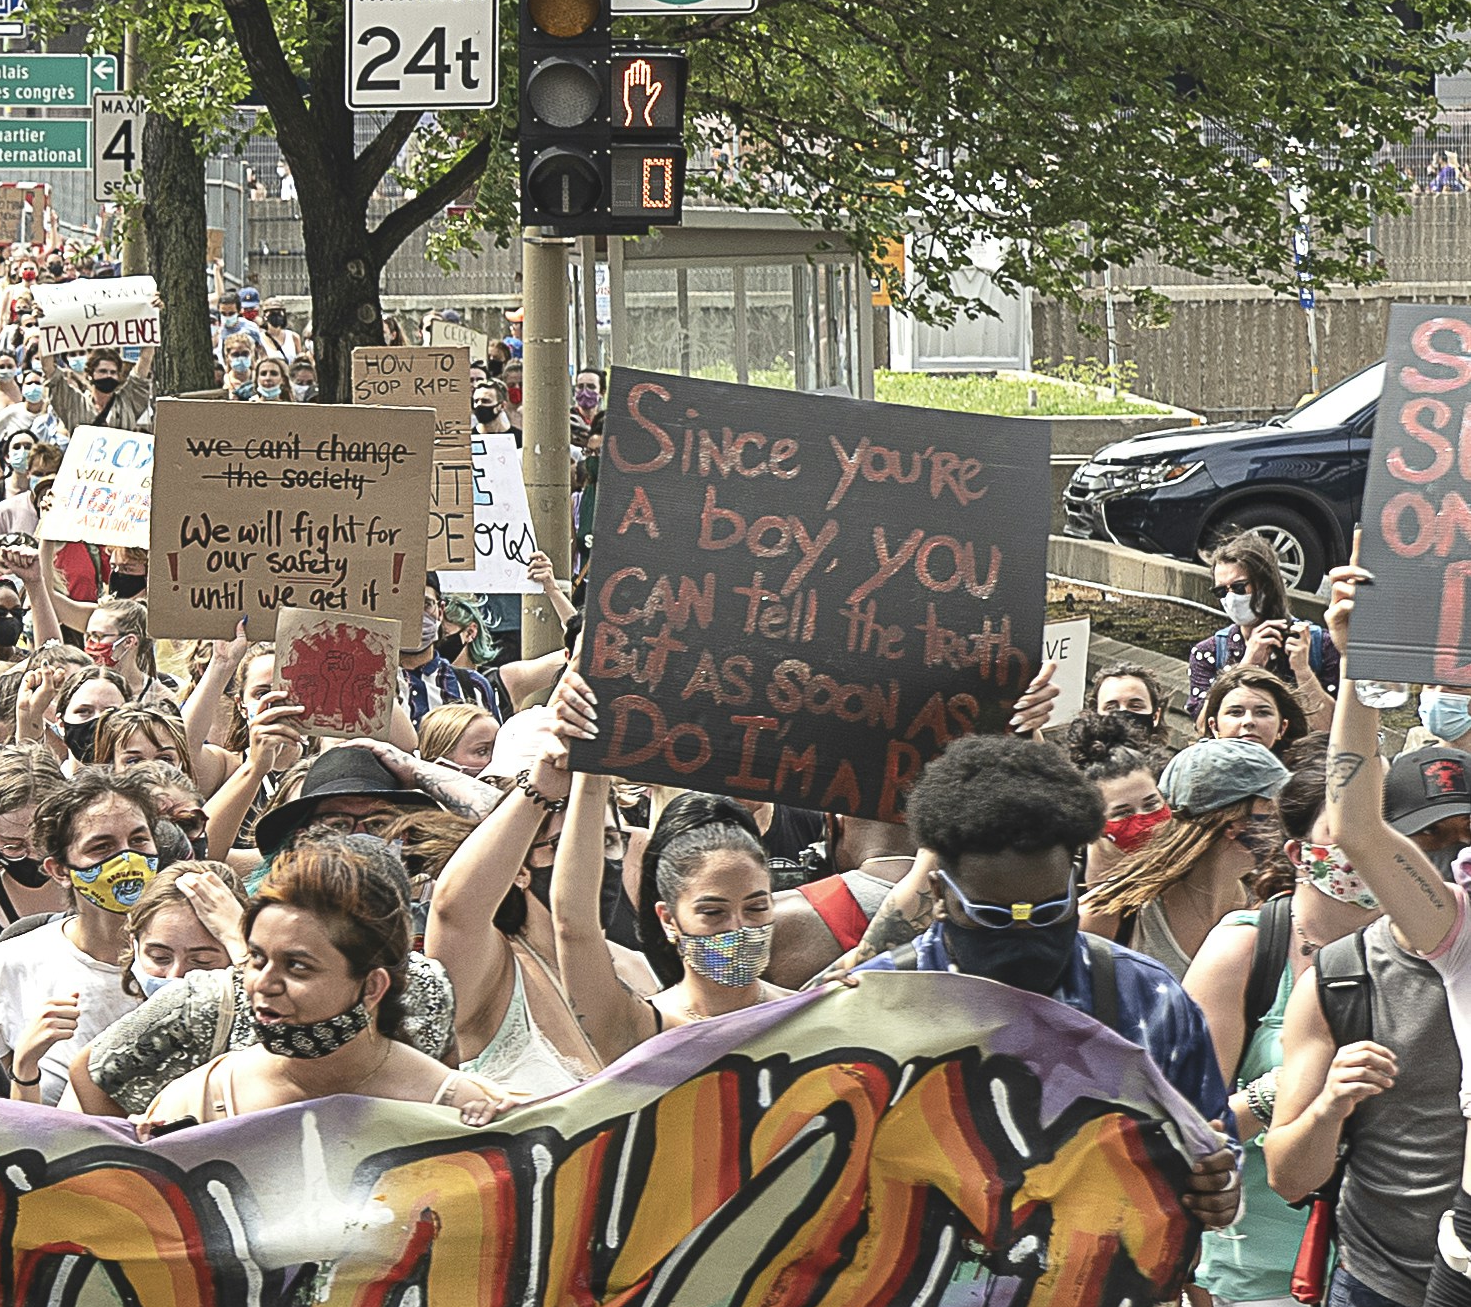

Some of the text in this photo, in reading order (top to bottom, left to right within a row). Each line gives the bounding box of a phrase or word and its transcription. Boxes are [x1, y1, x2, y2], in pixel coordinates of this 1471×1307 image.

[356, 25, 480, 92] 24t
[14, 83, 75, 103] congrès
[73, 318, 160, 348] VIOLENCE
[365, 353, 455, 376] HOW TO
[355, 377, 461, 400] STOP RAPE
[315, 433, 408, 476] change
[221, 462, 367, 500] the society
[180, 509, 402, 554] We will fight for
[206, 549, 349, 588] our safety
[190, 579, 380, 611] until we get it
[598, 566, 905, 660] CAN tell the
